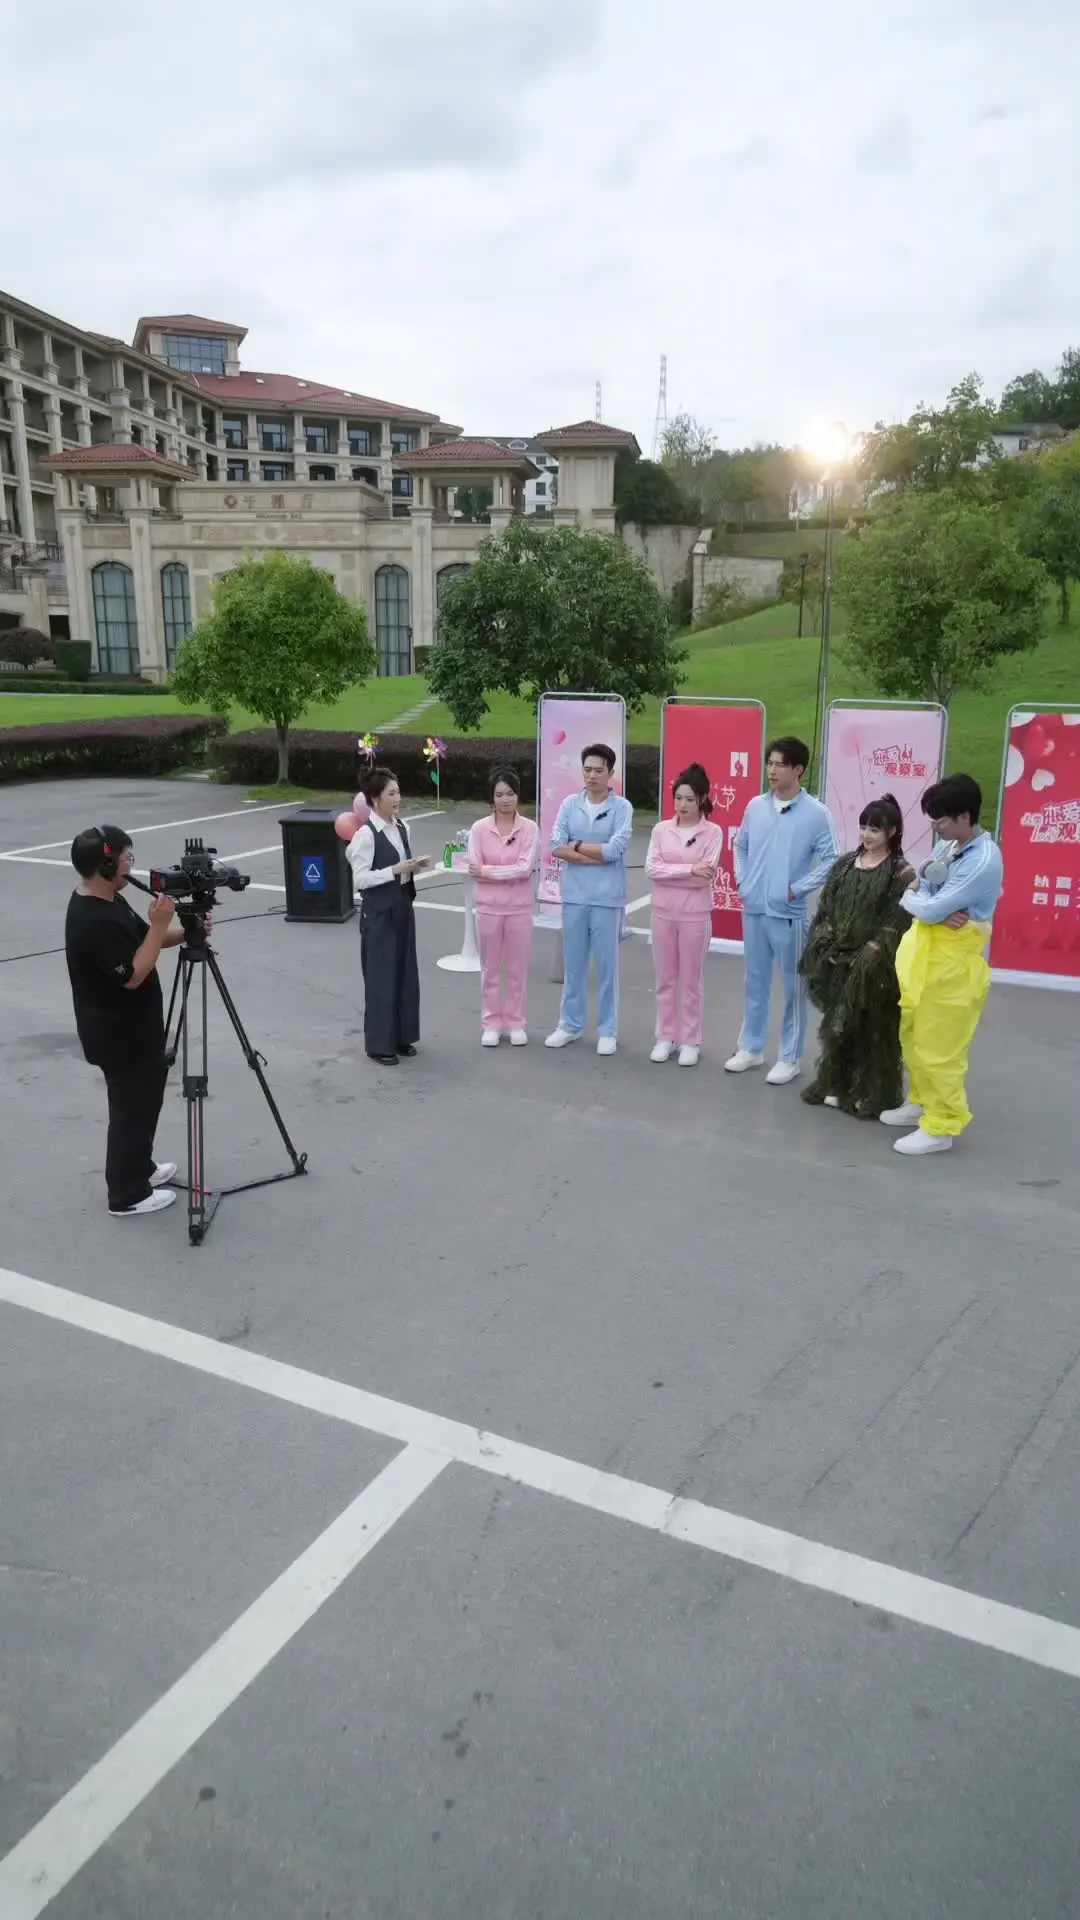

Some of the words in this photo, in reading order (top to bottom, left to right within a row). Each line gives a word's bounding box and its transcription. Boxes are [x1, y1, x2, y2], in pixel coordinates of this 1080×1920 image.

[885, 762, 926, 777] 观察室
[1058, 822, 1080, 842] 观
